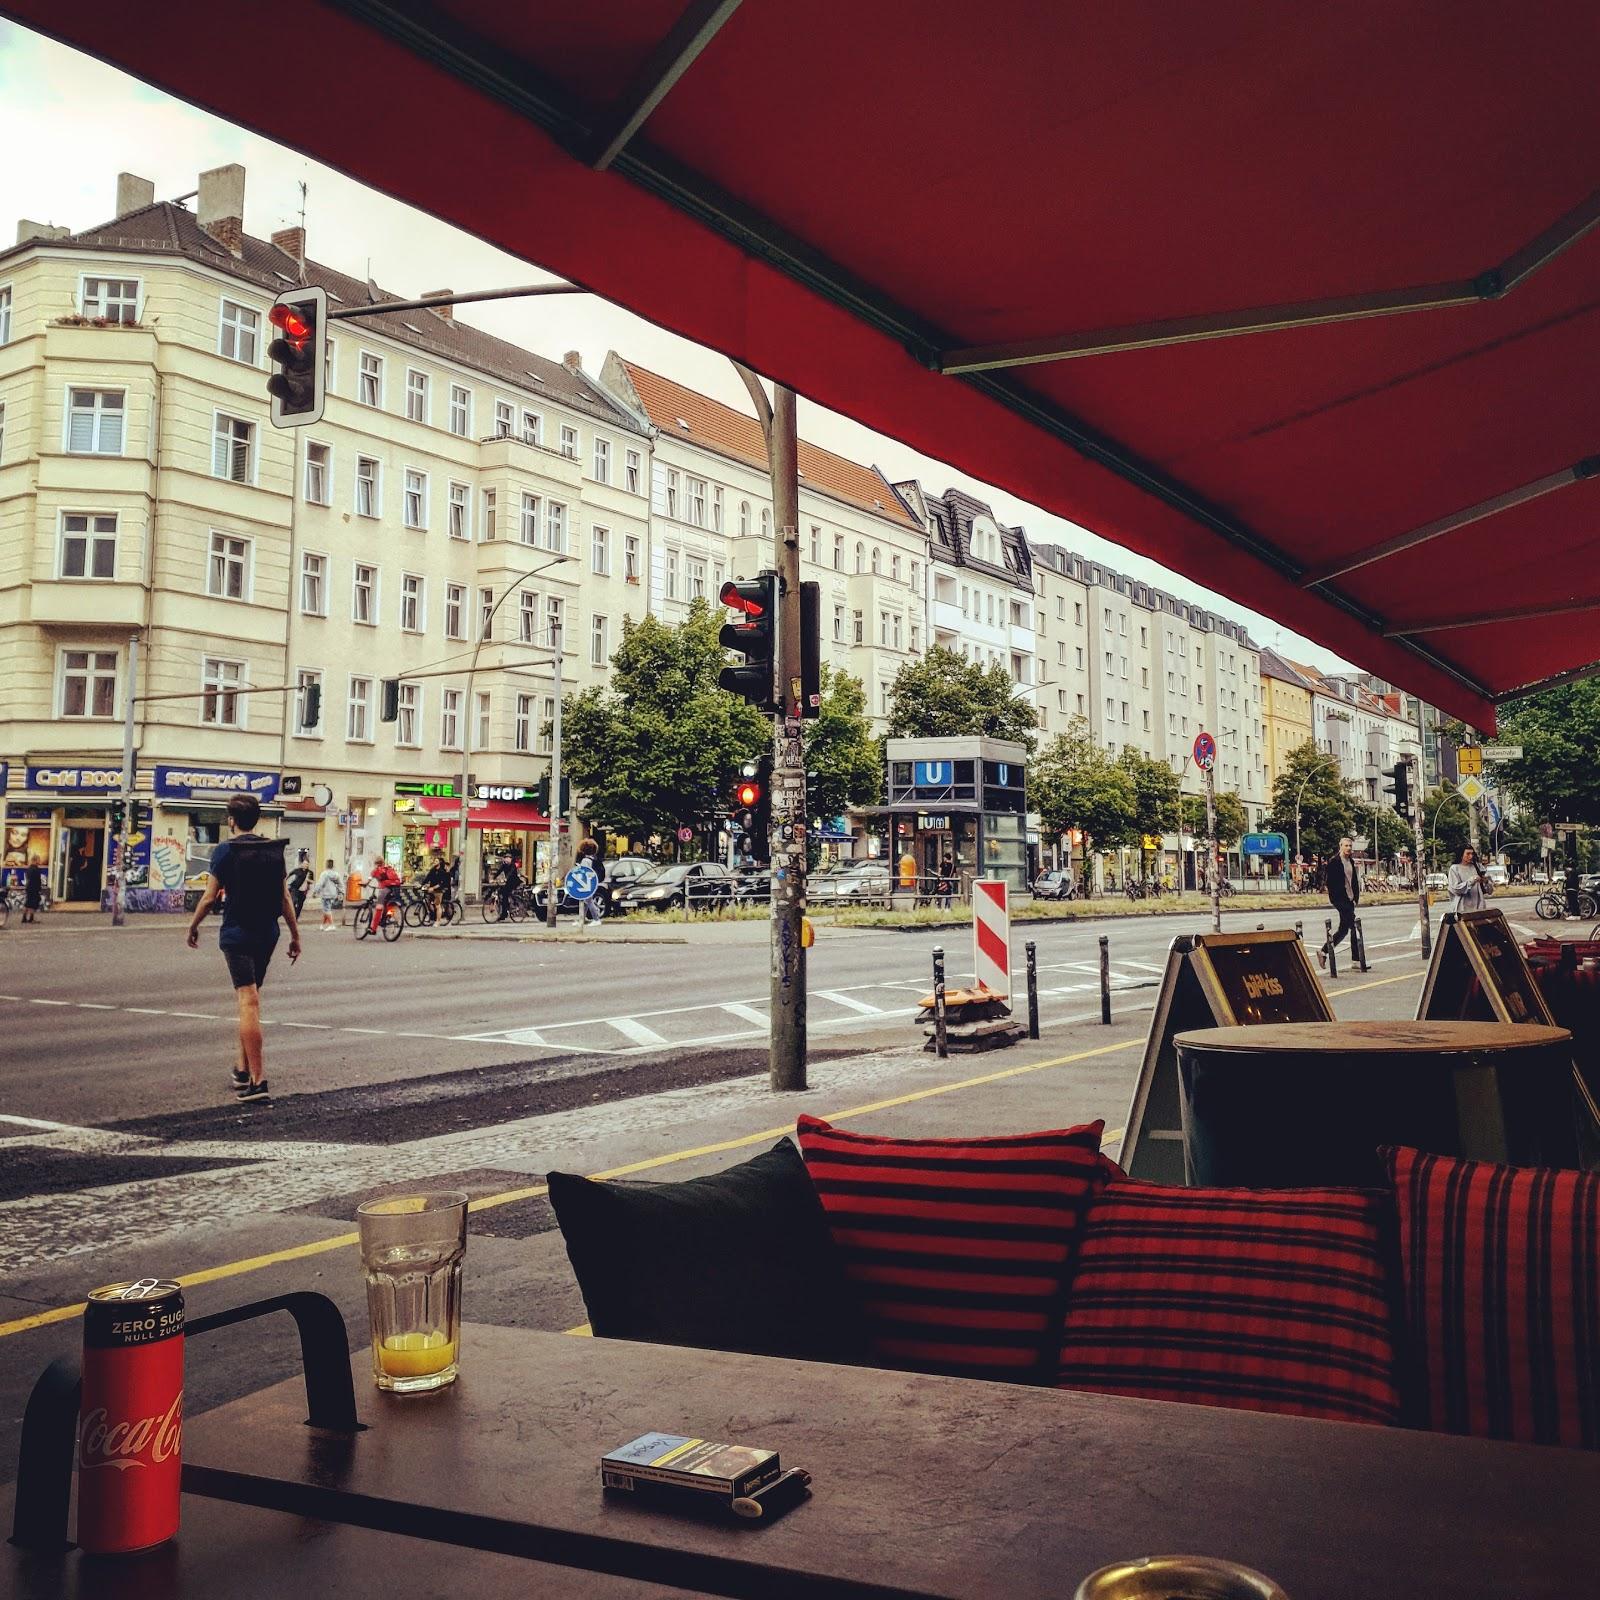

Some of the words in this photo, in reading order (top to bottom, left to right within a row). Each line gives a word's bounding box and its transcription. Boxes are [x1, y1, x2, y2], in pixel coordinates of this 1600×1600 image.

[926, 762, 942, 784] U
[1468, 763, 1474, 772] 5
[999, 763, 1008, 786] U
[284, 781, 297, 791] sky
[423, 783, 461, 797] KIE
[478, 786, 525, 800] SHOP
[924, 817, 934, 829] U
[1259, 839, 1268, 848] U
[112, 1318, 156, 1334] ZERO
[125, 1332, 155, 1342] NULL
